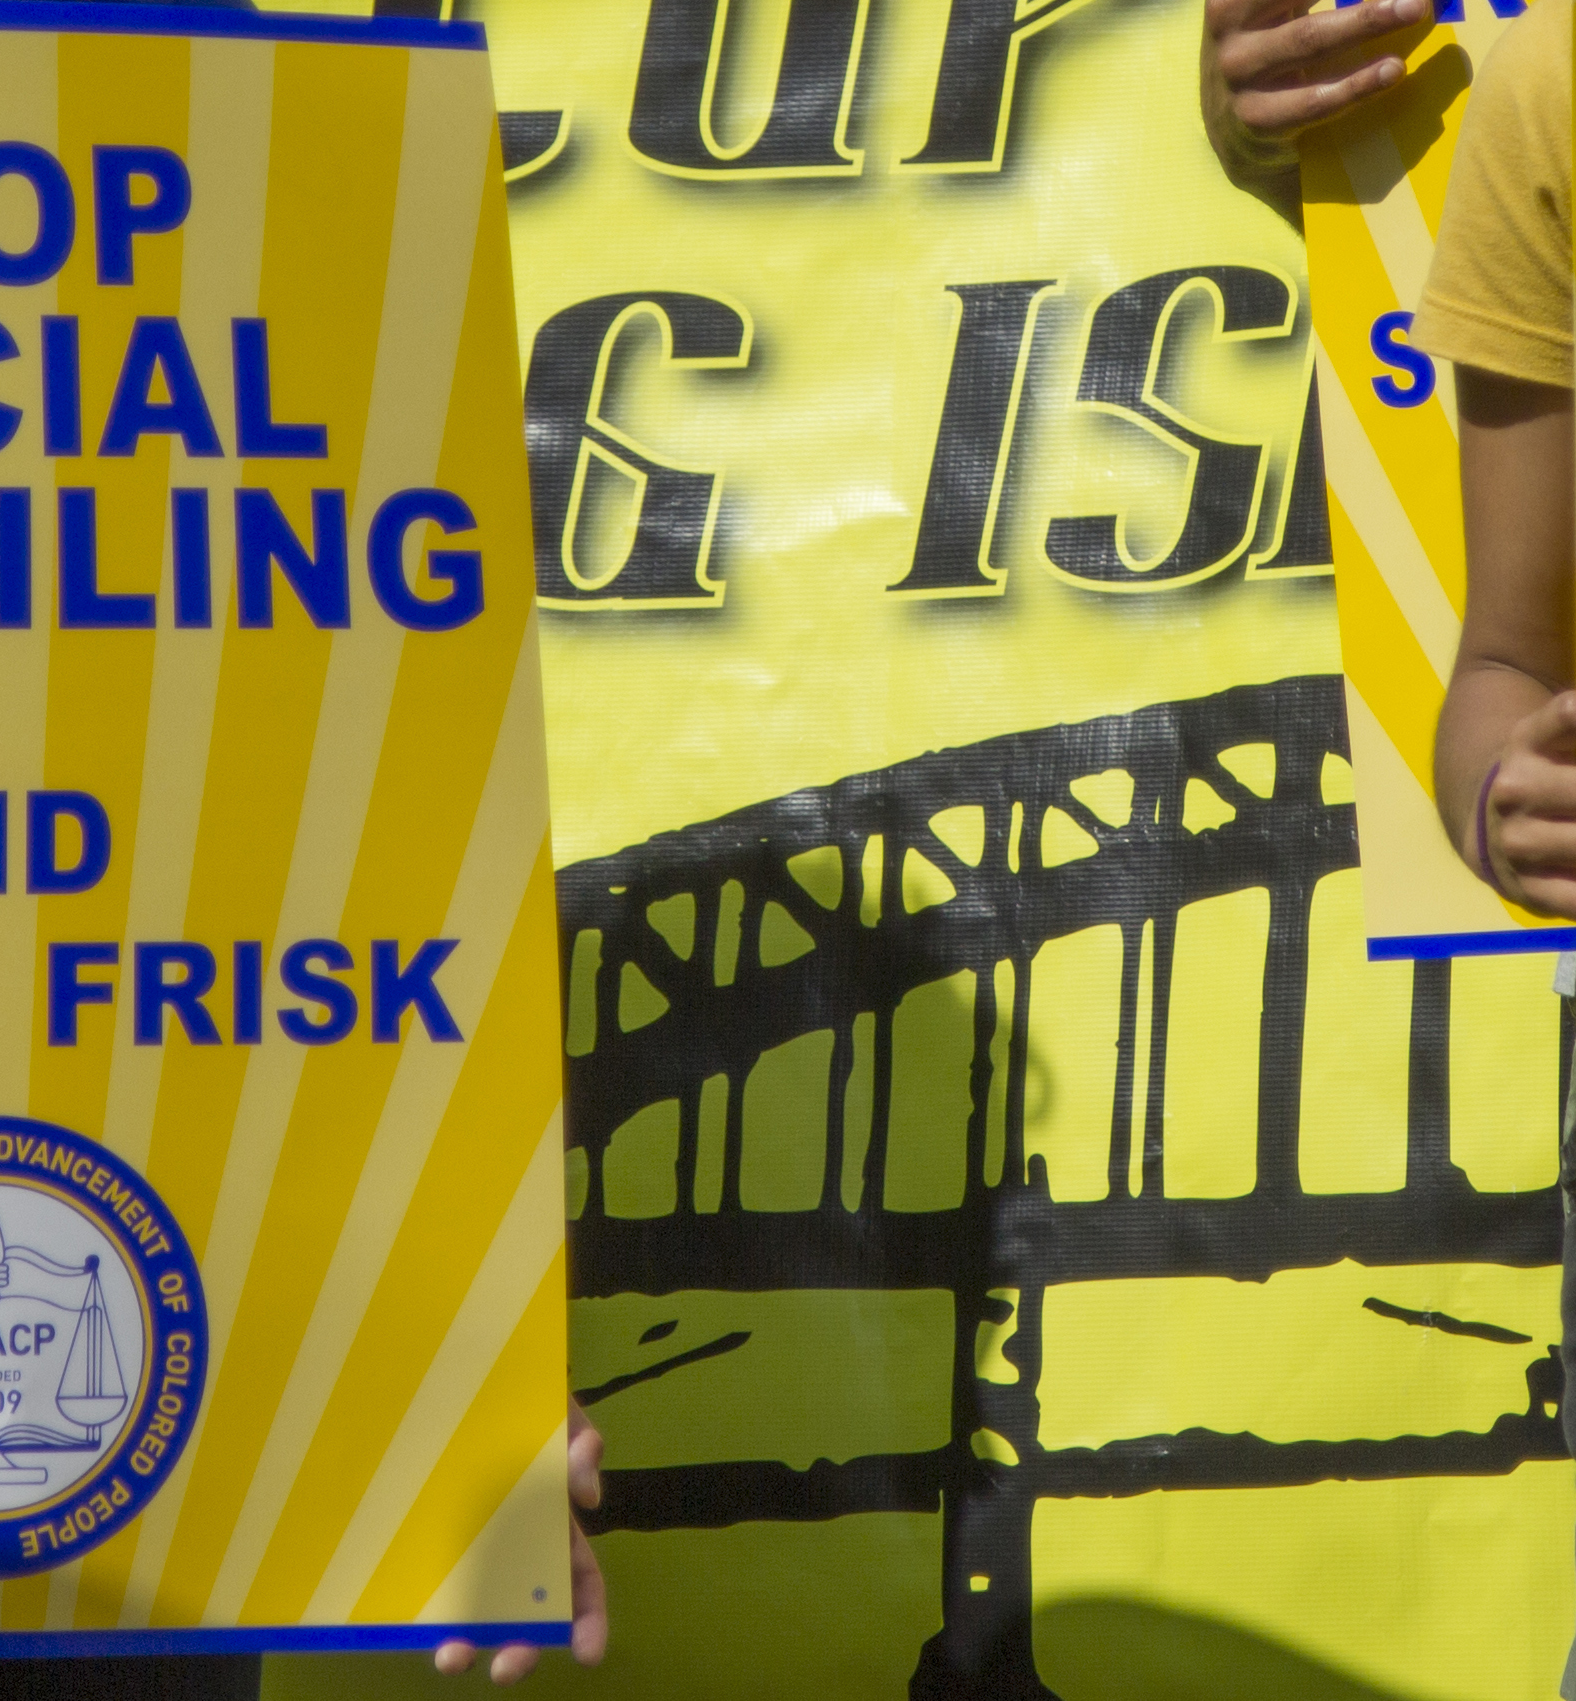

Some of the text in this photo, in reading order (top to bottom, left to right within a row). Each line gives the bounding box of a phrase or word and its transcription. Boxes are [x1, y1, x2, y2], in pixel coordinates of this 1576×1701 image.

[48, 938, 465, 1047] FRISK
[158, 1273, 188, 1312] OF
[131, 1333, 191, 1475] COLORED
[19, 1481, 131, 1557] PEOPLE
